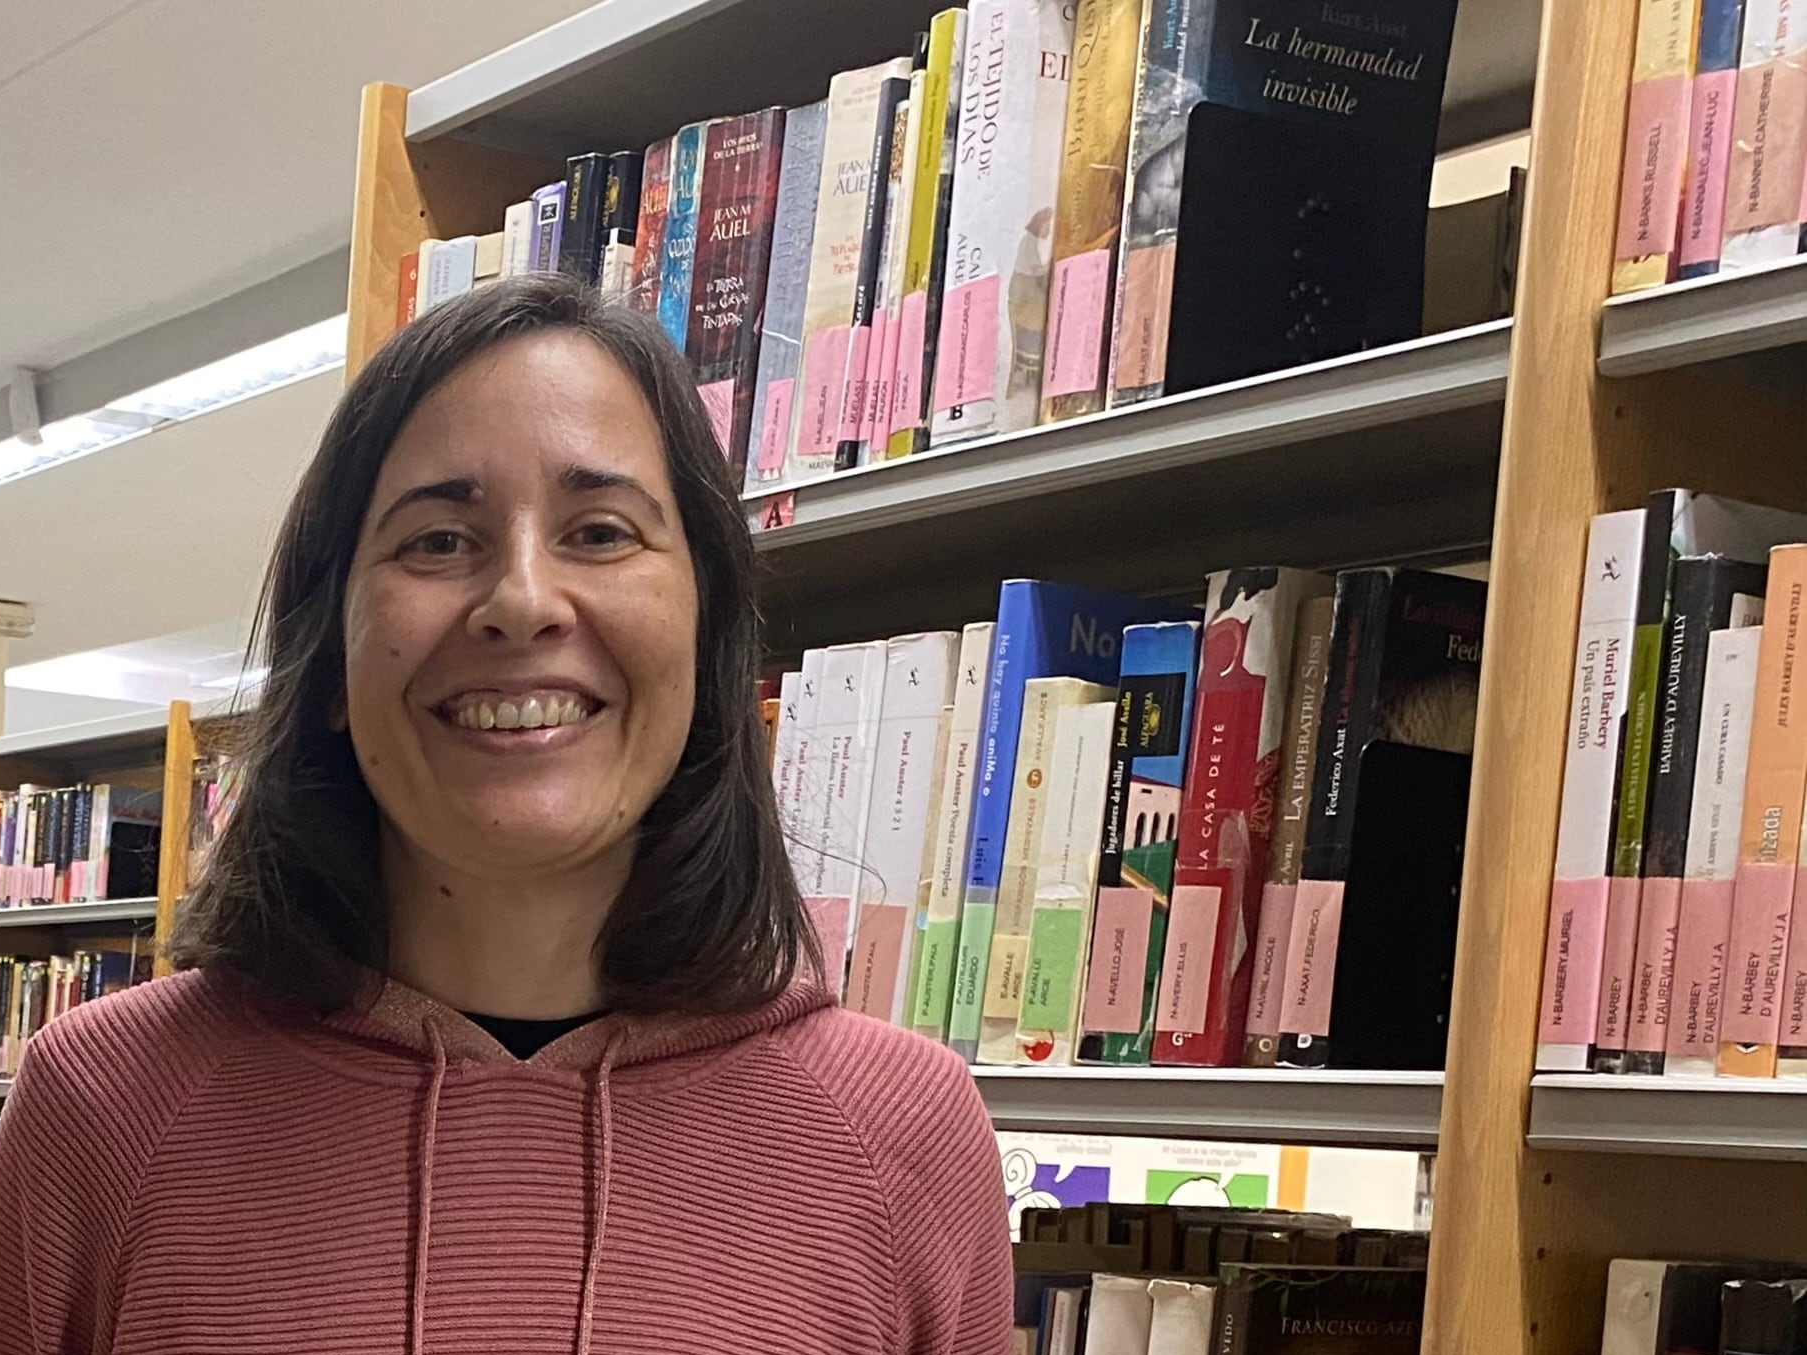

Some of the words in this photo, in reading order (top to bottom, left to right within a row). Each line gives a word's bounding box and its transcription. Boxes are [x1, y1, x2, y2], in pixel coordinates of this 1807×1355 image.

[1245, 17, 1278, 49] La
[1287, 27, 1423, 80] hermandad
[1263, 71, 1358, 115] invisible
[710, 220, 751, 242] AUEL
[764, 501, 783, 530] A
[1603, 638, 1620, 686] Muriel
[1594, 690, 1615, 749] Barbery
[1209, 754, 1220, 777] DE
[1333, 729, 1346, 759] Axat
[1659, 719, 1677, 774] BARBEY
[1325, 762, 1342, 816] Federico
[1202, 789, 1218, 838] CASA
